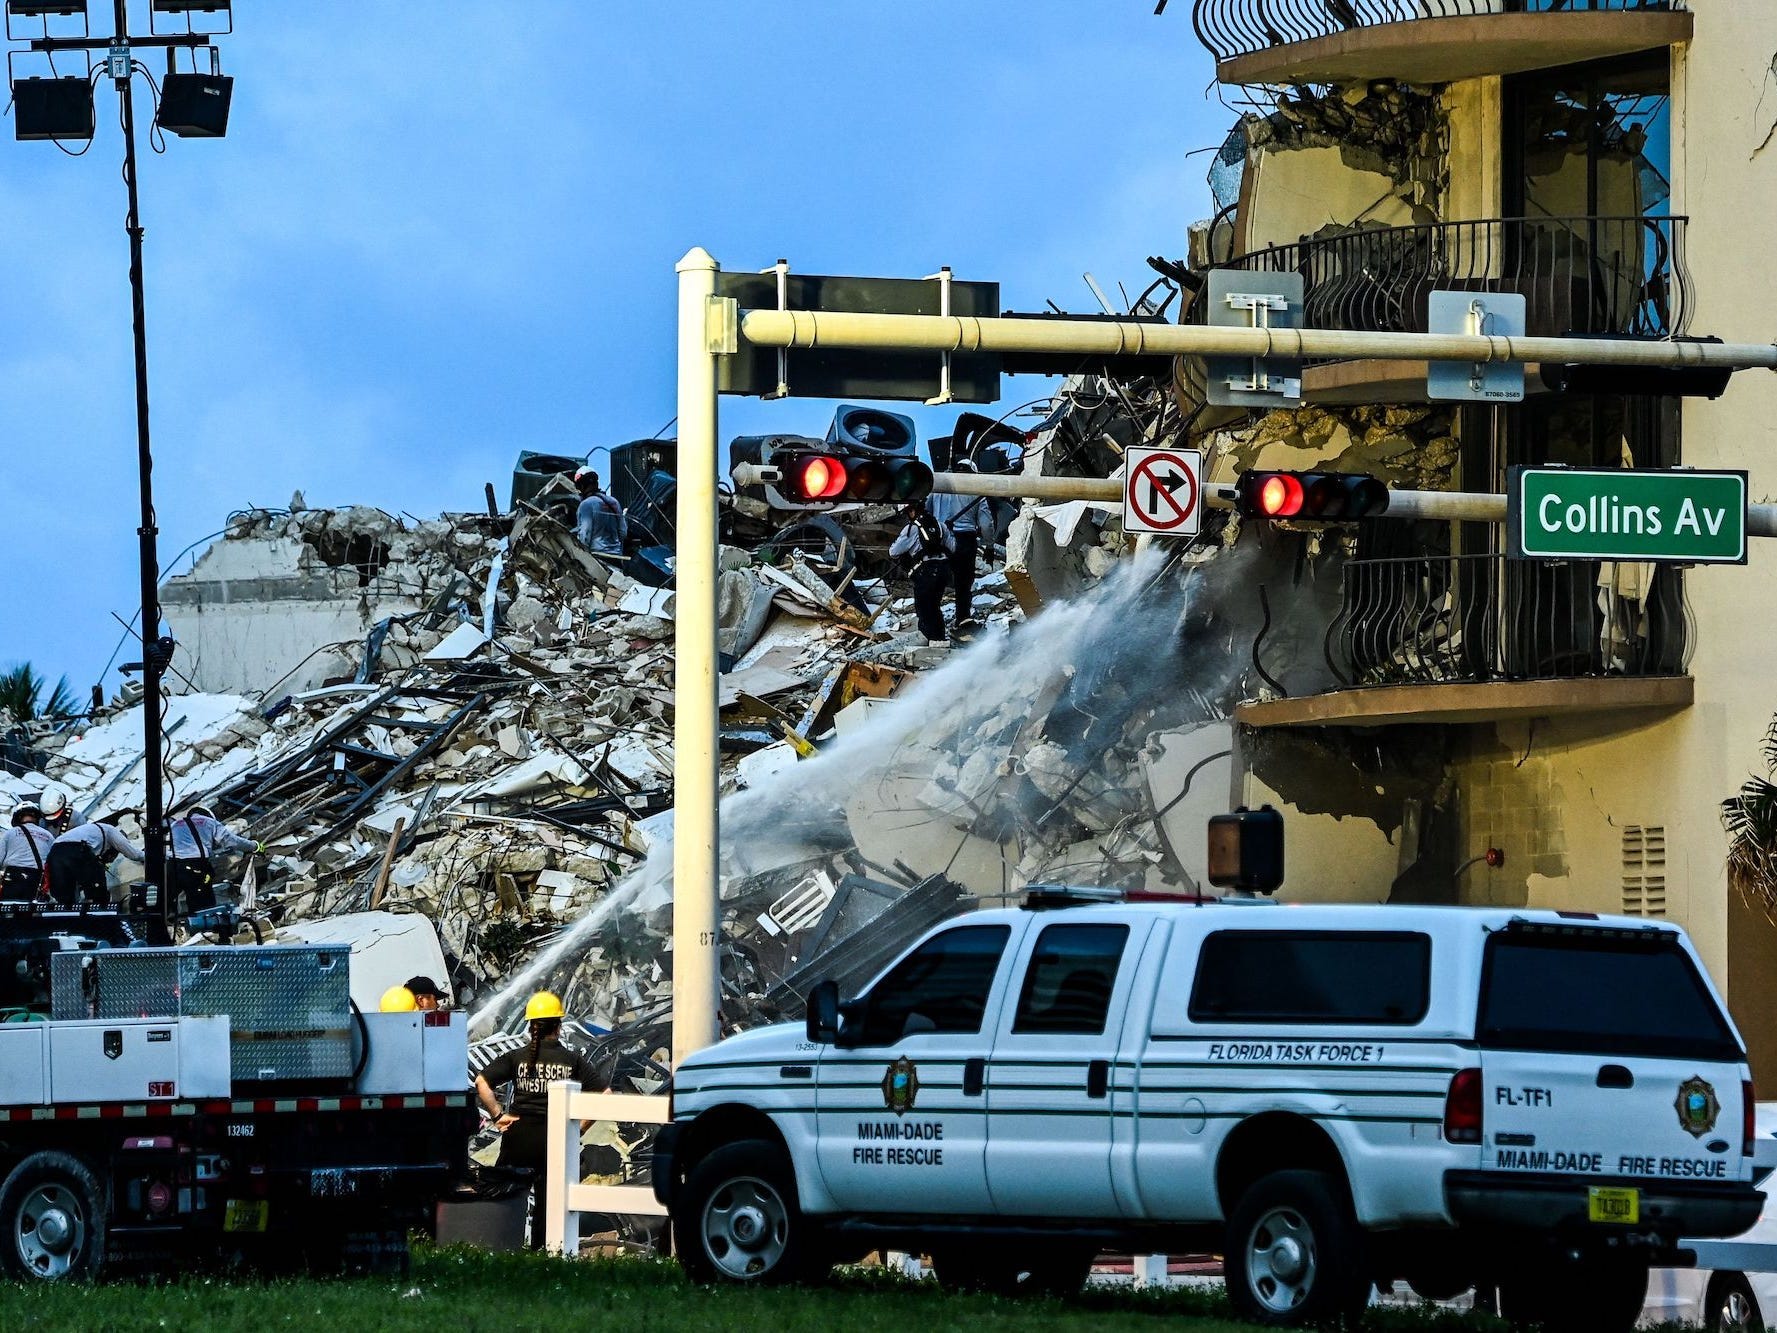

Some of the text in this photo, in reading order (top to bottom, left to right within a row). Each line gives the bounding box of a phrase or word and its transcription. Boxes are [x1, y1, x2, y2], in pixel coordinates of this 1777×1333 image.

[1539, 493, 1726, 536] Collins Av
[1208, 1044, 1384, 1062] FLORIDA TASK FORCE 1
[1495, 1087, 1552, 1107] FL-TF1
[227, 1125, 254, 1137] 132462
[858, 1122, 943, 1140] MIAMI-DADE
[853, 1148, 943, 1165] FIRE RESCUE
[1497, 1150, 1727, 1178] MIAMI-DADE FIRE RESCUE
